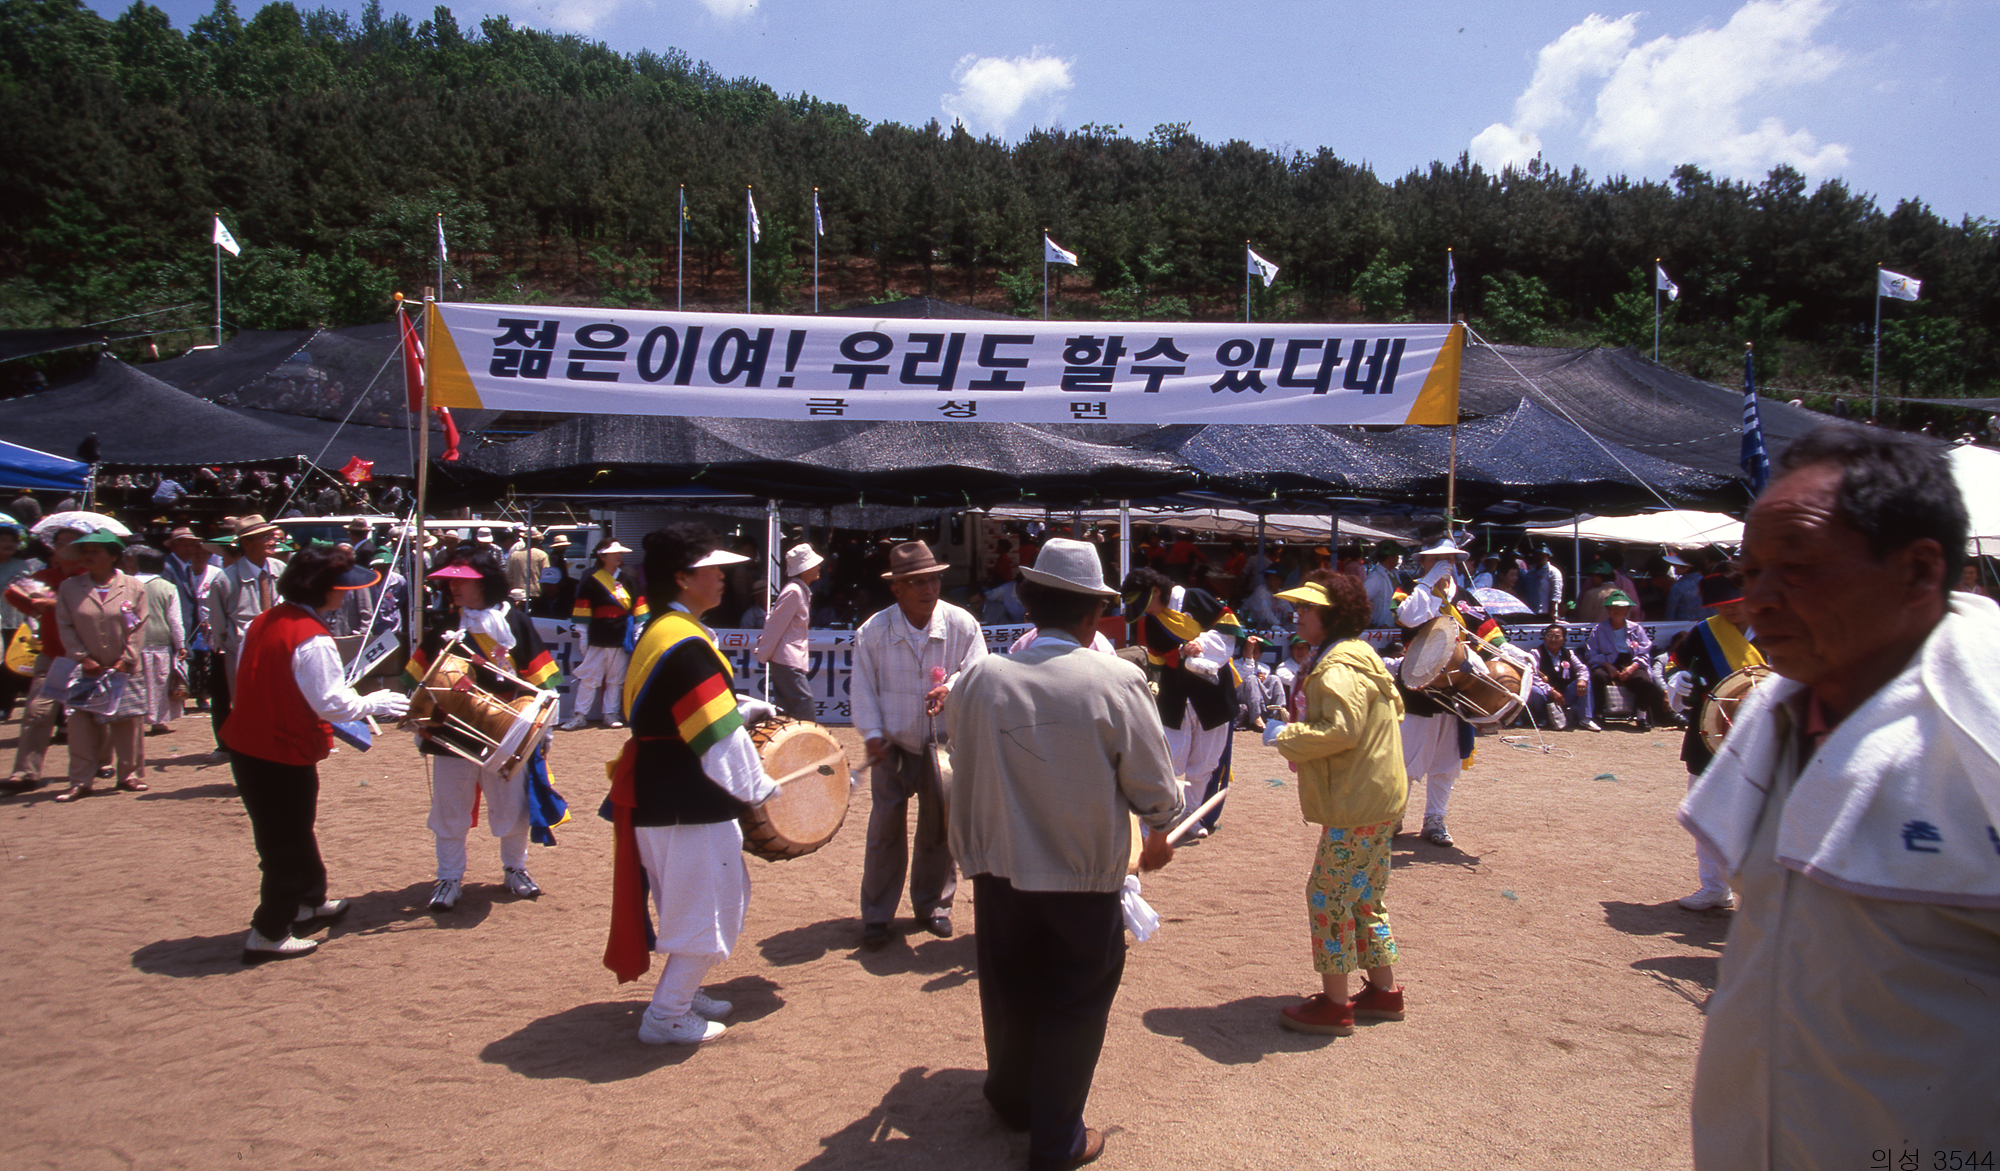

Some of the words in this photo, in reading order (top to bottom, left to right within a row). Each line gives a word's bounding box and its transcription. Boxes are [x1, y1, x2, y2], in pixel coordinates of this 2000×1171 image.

[489, 318, 807, 388] 젊은이여!
[831, 331, 1035, 391] 우리도
[1209, 337, 1407, 395] 있다네
